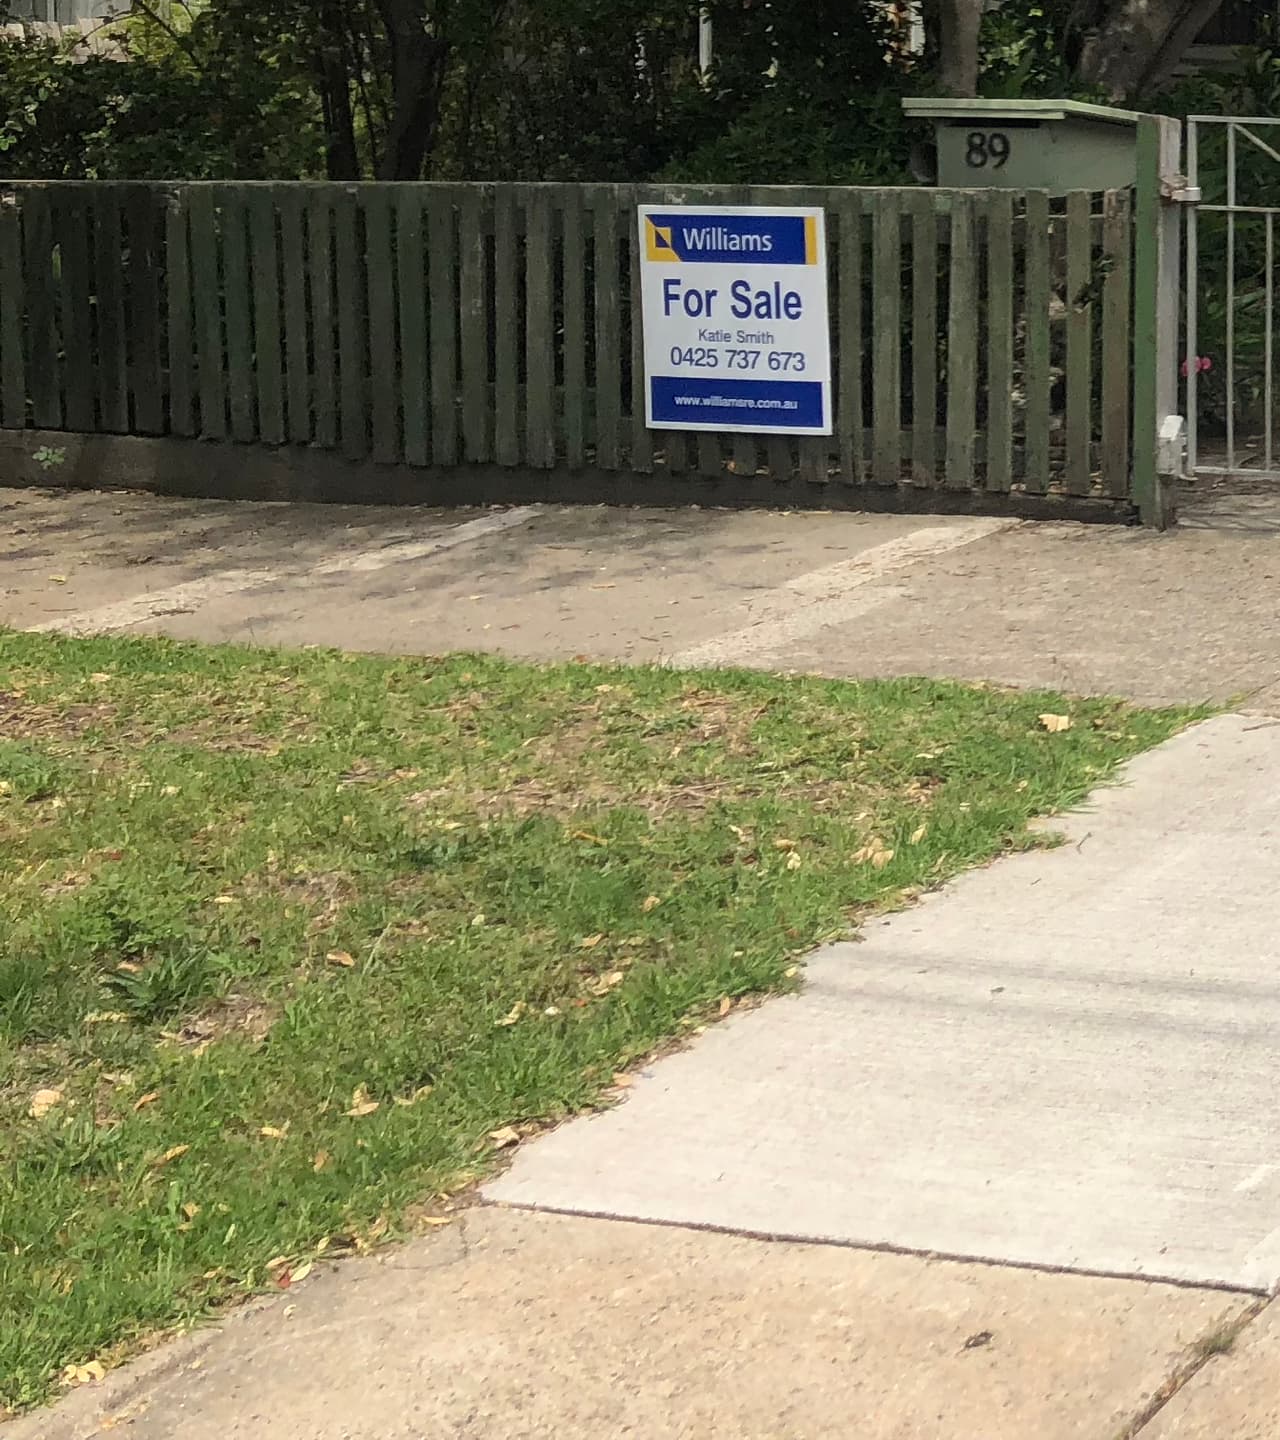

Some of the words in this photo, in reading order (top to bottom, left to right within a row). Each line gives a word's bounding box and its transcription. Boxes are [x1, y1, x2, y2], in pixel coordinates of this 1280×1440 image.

[965, 132, 1010, 169] 89
[682, 227, 773, 252] Williams
[663, 278, 717, 318] For
[730, 279, 803, 320] Sale
[698, 329, 732, 343] Katie
[736, 330, 775, 345] Smith
[670, 346, 718, 368] 0425
[725, 349, 761, 370] 737
[767, 351, 806, 372] 673
